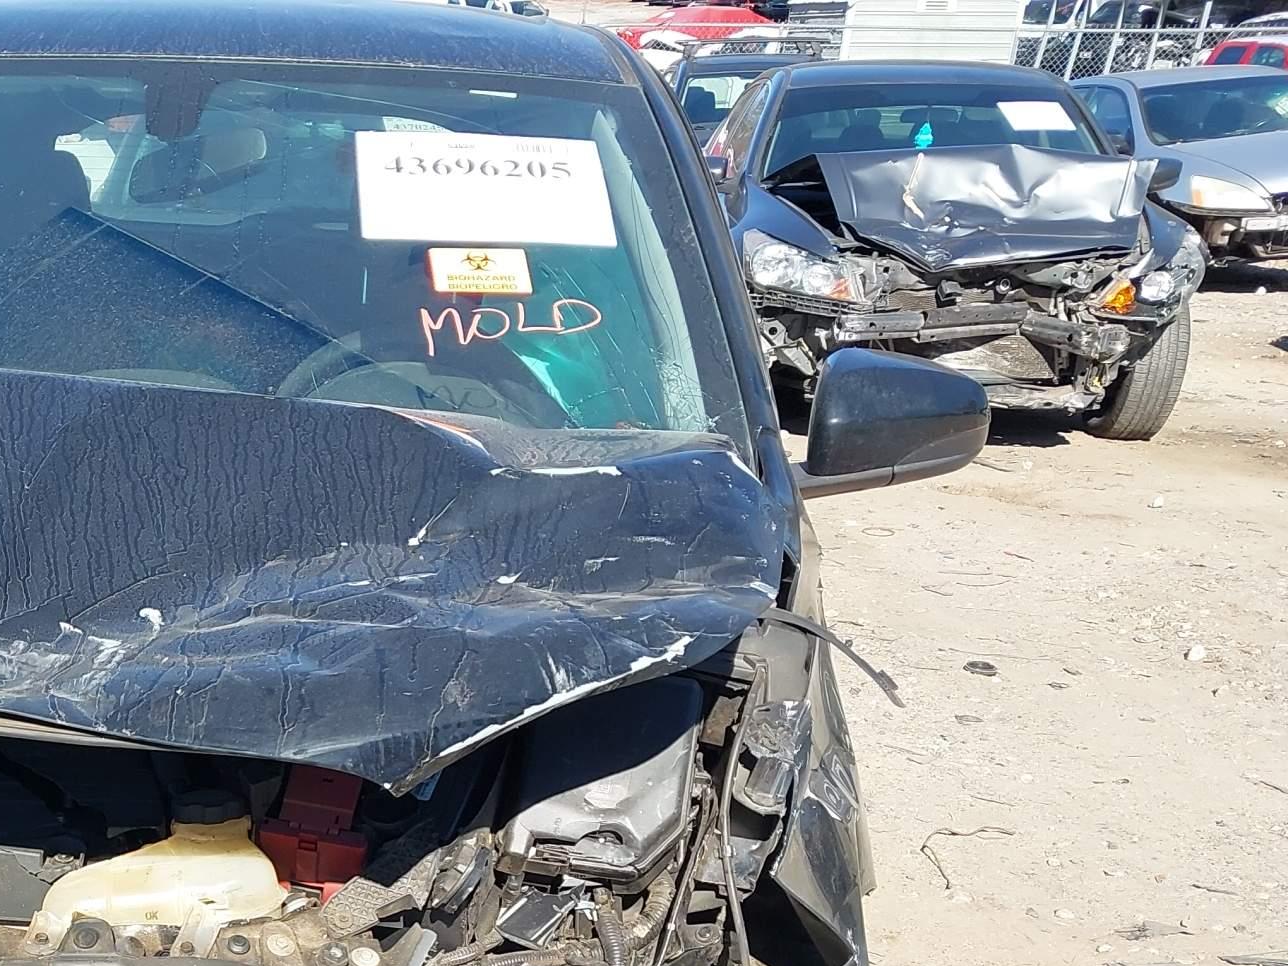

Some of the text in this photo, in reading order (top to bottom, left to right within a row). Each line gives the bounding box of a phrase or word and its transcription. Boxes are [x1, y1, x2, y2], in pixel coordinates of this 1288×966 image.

[384, 155, 572, 180] 43696205
[446, 274, 517, 282] BIOHAZARD
[447, 283, 519, 291] BIOPELIGRO
[418, 298, 603, 358] MOLD
